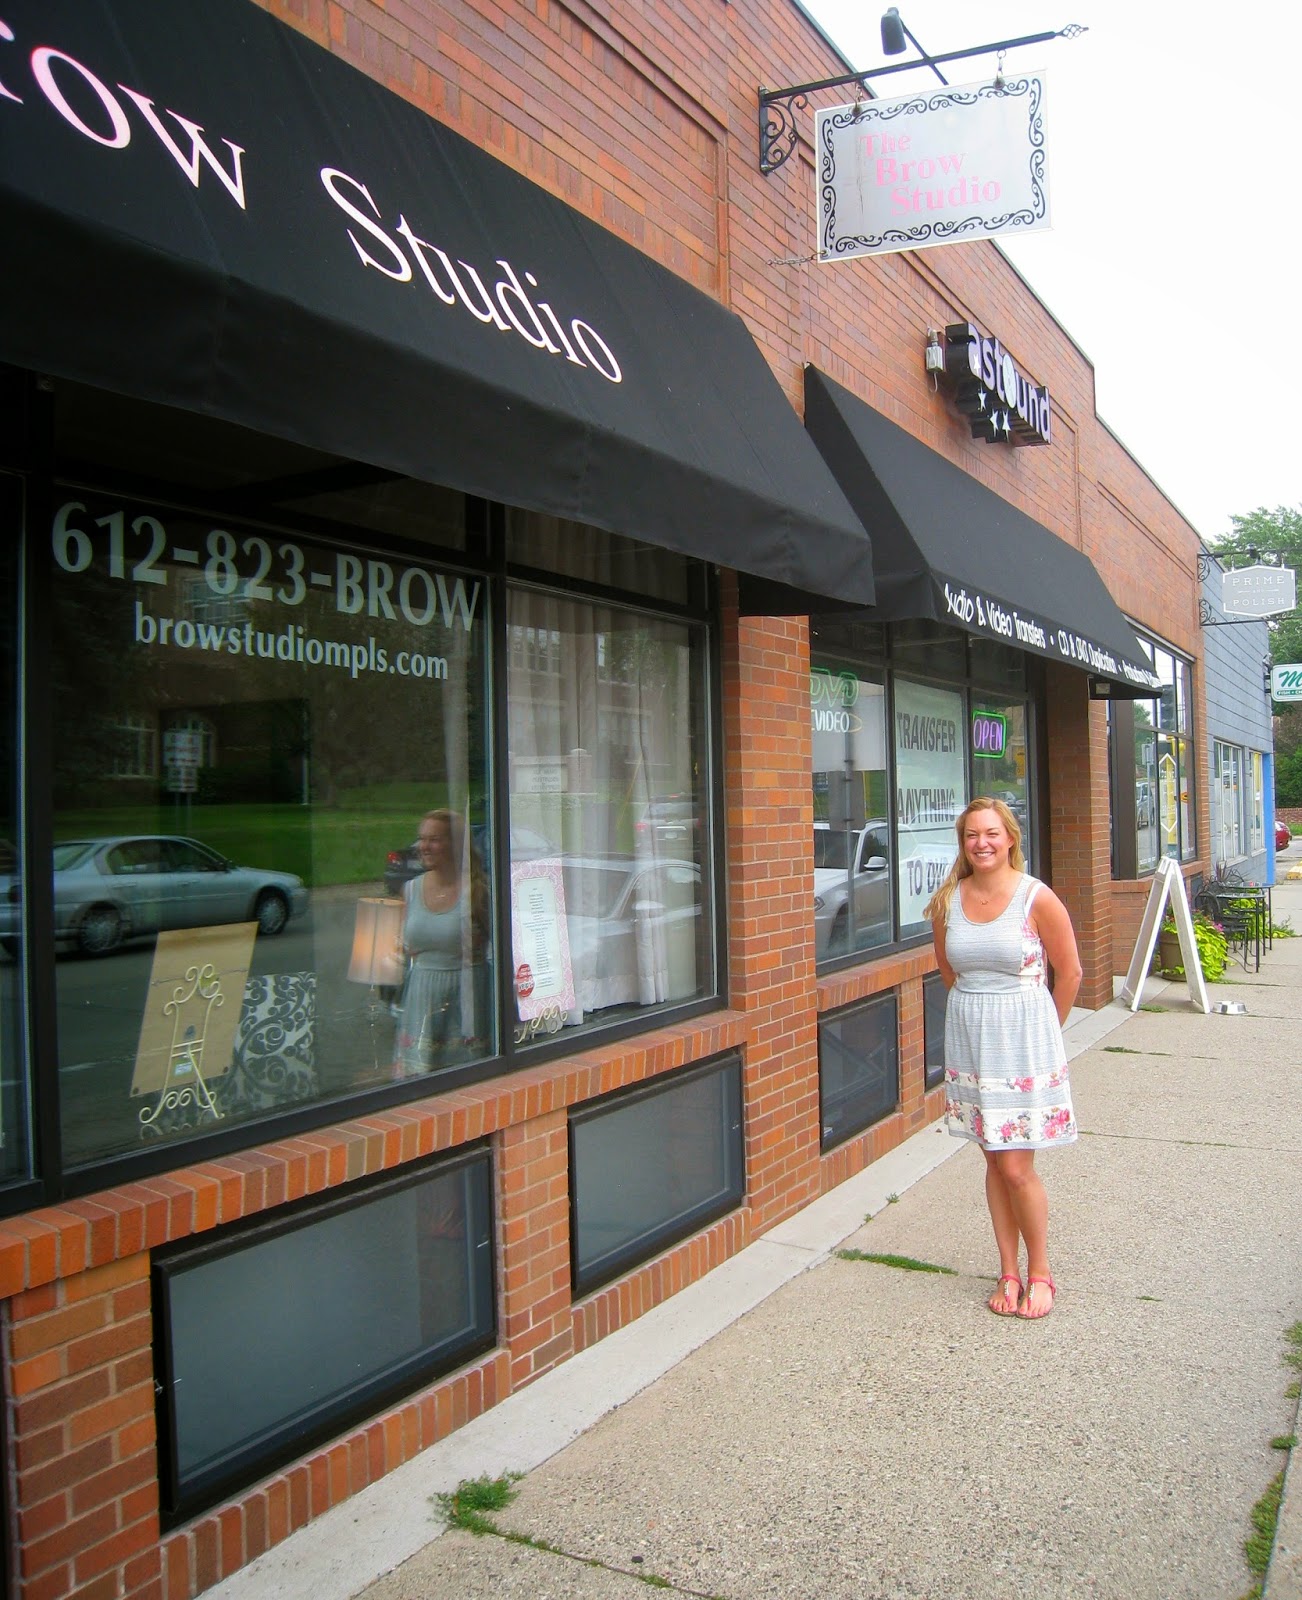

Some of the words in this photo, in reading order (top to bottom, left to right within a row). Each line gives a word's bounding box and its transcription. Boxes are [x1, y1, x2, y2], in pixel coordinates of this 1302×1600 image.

[860, 131, 911, 158] The
[875, 151, 968, 187] Brow
[0, 20, 246, 210] ow
[320, 168, 623, 384] Studio
[890, 175, 1002, 217] Studio
[967, 322, 1051, 445] astound
[52, 501, 481, 631] 612-823-BROW
[1232, 575, 1285, 587] PRIME
[944, 583, 974, 623] Audio
[976, 595, 986, 627] &
[986, 600, 1012, 638] Video
[1013, 611, 1046, 650] Transfers
[1057, 629, 1070, 656] CD
[1233, 597, 1285, 607] POLISH
[134, 601, 449, 680] browstudiompls.com
[814, 709, 850, 733] VIDEO
[897, 711, 956, 753] TRANSFER
[973, 719, 1003, 751] OPEN
[898, 788, 955, 825] ANYTHING
[906, 859, 923, 897] TO
